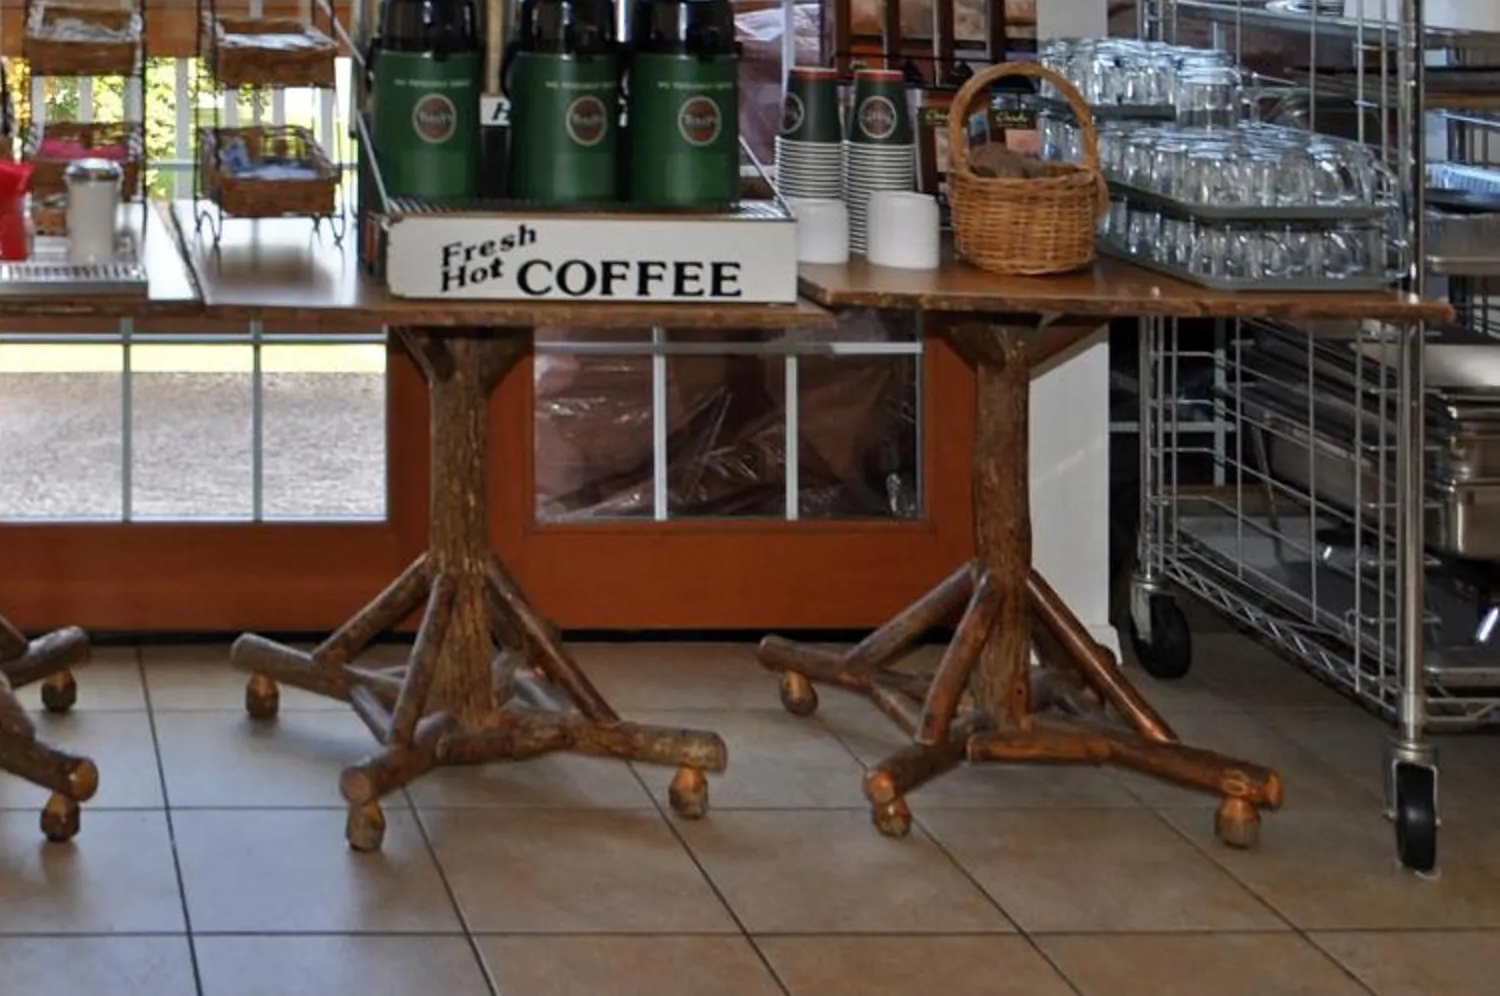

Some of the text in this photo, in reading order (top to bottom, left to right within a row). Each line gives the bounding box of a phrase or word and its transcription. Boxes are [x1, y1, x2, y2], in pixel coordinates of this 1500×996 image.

[440, 224, 537, 269] Fresh
[440, 257, 742, 297] Hot COFFEE
